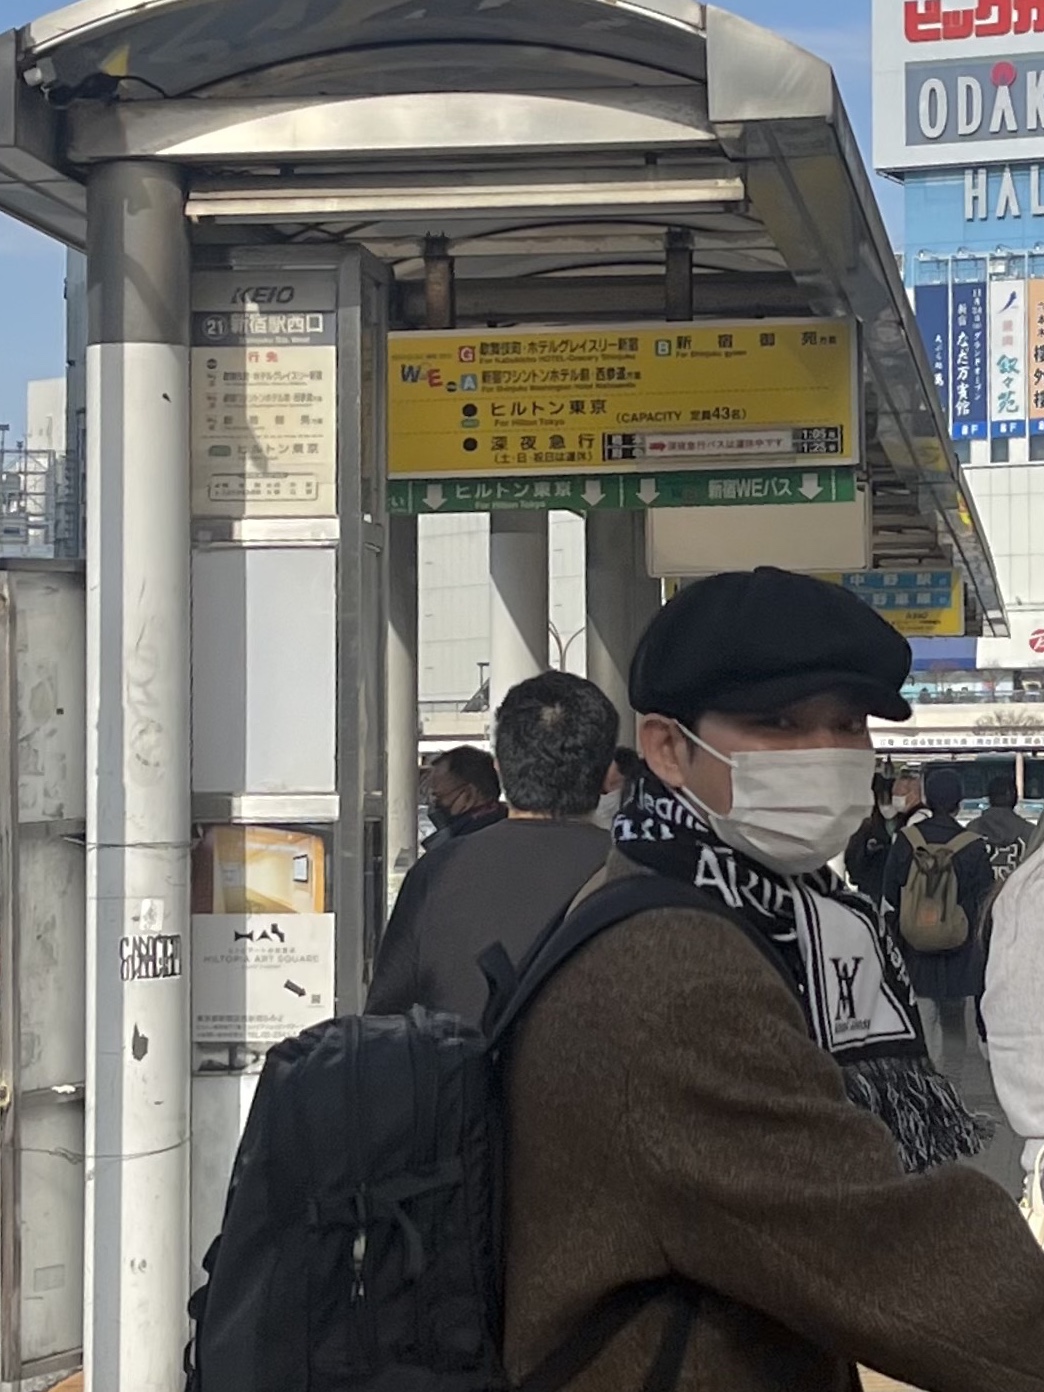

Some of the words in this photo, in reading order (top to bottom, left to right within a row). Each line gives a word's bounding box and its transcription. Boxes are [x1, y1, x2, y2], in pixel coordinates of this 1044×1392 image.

[230, 285, 295, 304] KEIO
[230, 311, 324, 334] 新宿駅西口
[491, 399, 607, 416] ヒルトン東京
[490, 433, 595, 451] 深夜急行
[455, 481, 572, 499] ヒルトン東京
[708, 477, 792, 499] 新宿WEバス
